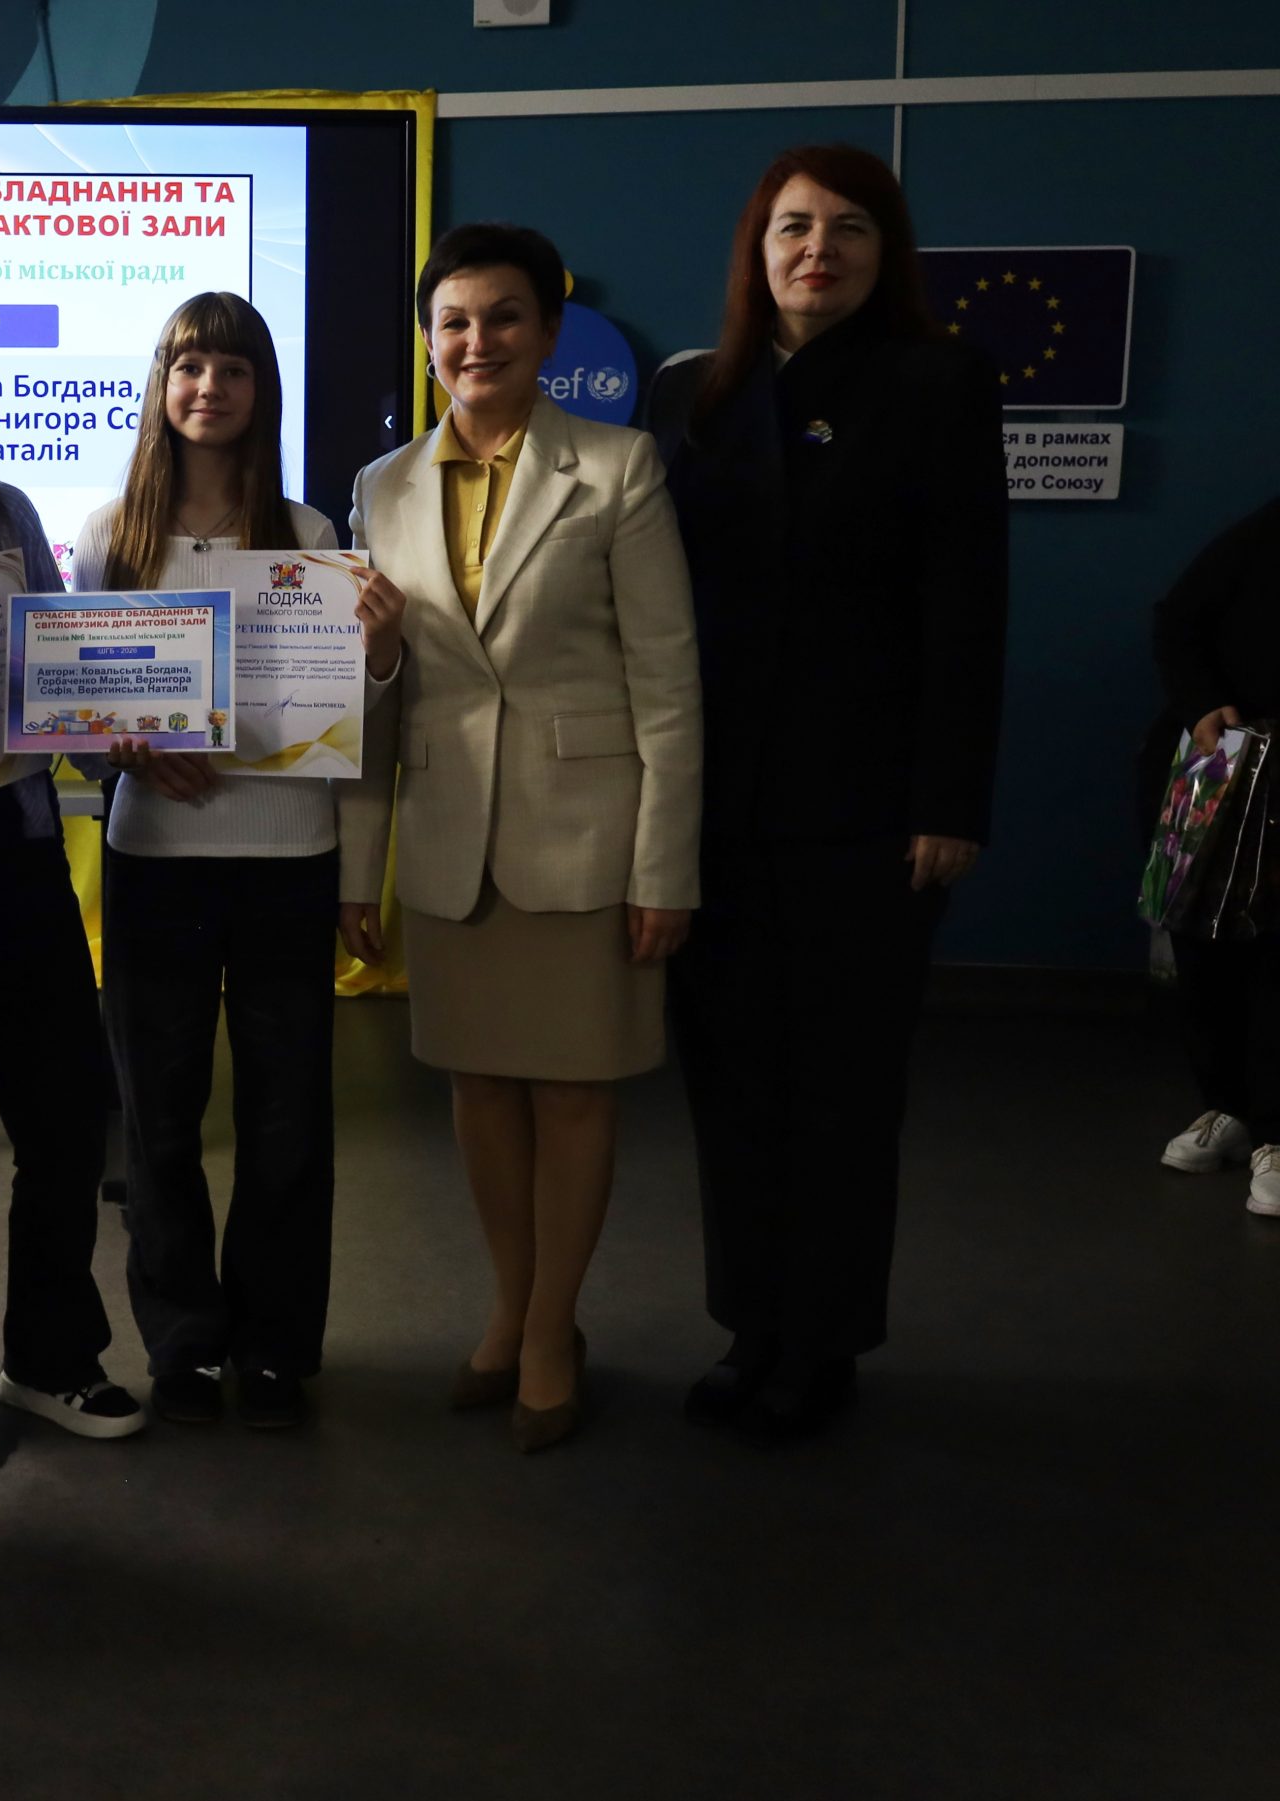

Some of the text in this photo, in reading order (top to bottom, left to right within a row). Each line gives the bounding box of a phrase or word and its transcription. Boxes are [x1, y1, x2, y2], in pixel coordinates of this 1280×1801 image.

[195, 181, 235, 203] ТА
[142, 214, 226, 237] ЗАЛИ
[18, 260, 113, 281] міської
[121, 264, 185, 286] ради
[13, 375, 142, 403] Богдана,
[1025, 433, 1036, 445] в
[1042, 433, 1111, 448] рамках
[1013, 456, 1108, 469] допомоги
[1041, 475, 1104, 493] Союзу
[258, 592, 323, 607] ПОДЯКА
[33, 611, 76, 620] СУЧАСНЕ
[80, 610, 123, 618] ЗВУКОВЕ
[126, 608, 193, 618] ОБЛАДНАННЯ
[35, 617, 206, 629] СВІТЛОМУЗИКА ДЛЯ АКТОВОЇ ЗАЛИ
[235, 623, 309, 634] РЕТИНСЬКІЙ
[167, 632, 185, 641] ради
[37, 665, 192, 677] Автори: Ковальська Богдана,
[37, 675, 192, 687] Горбаченко Марія, Вернигора
[40, 684, 188, 696] Софія, Веретинська Наталія
